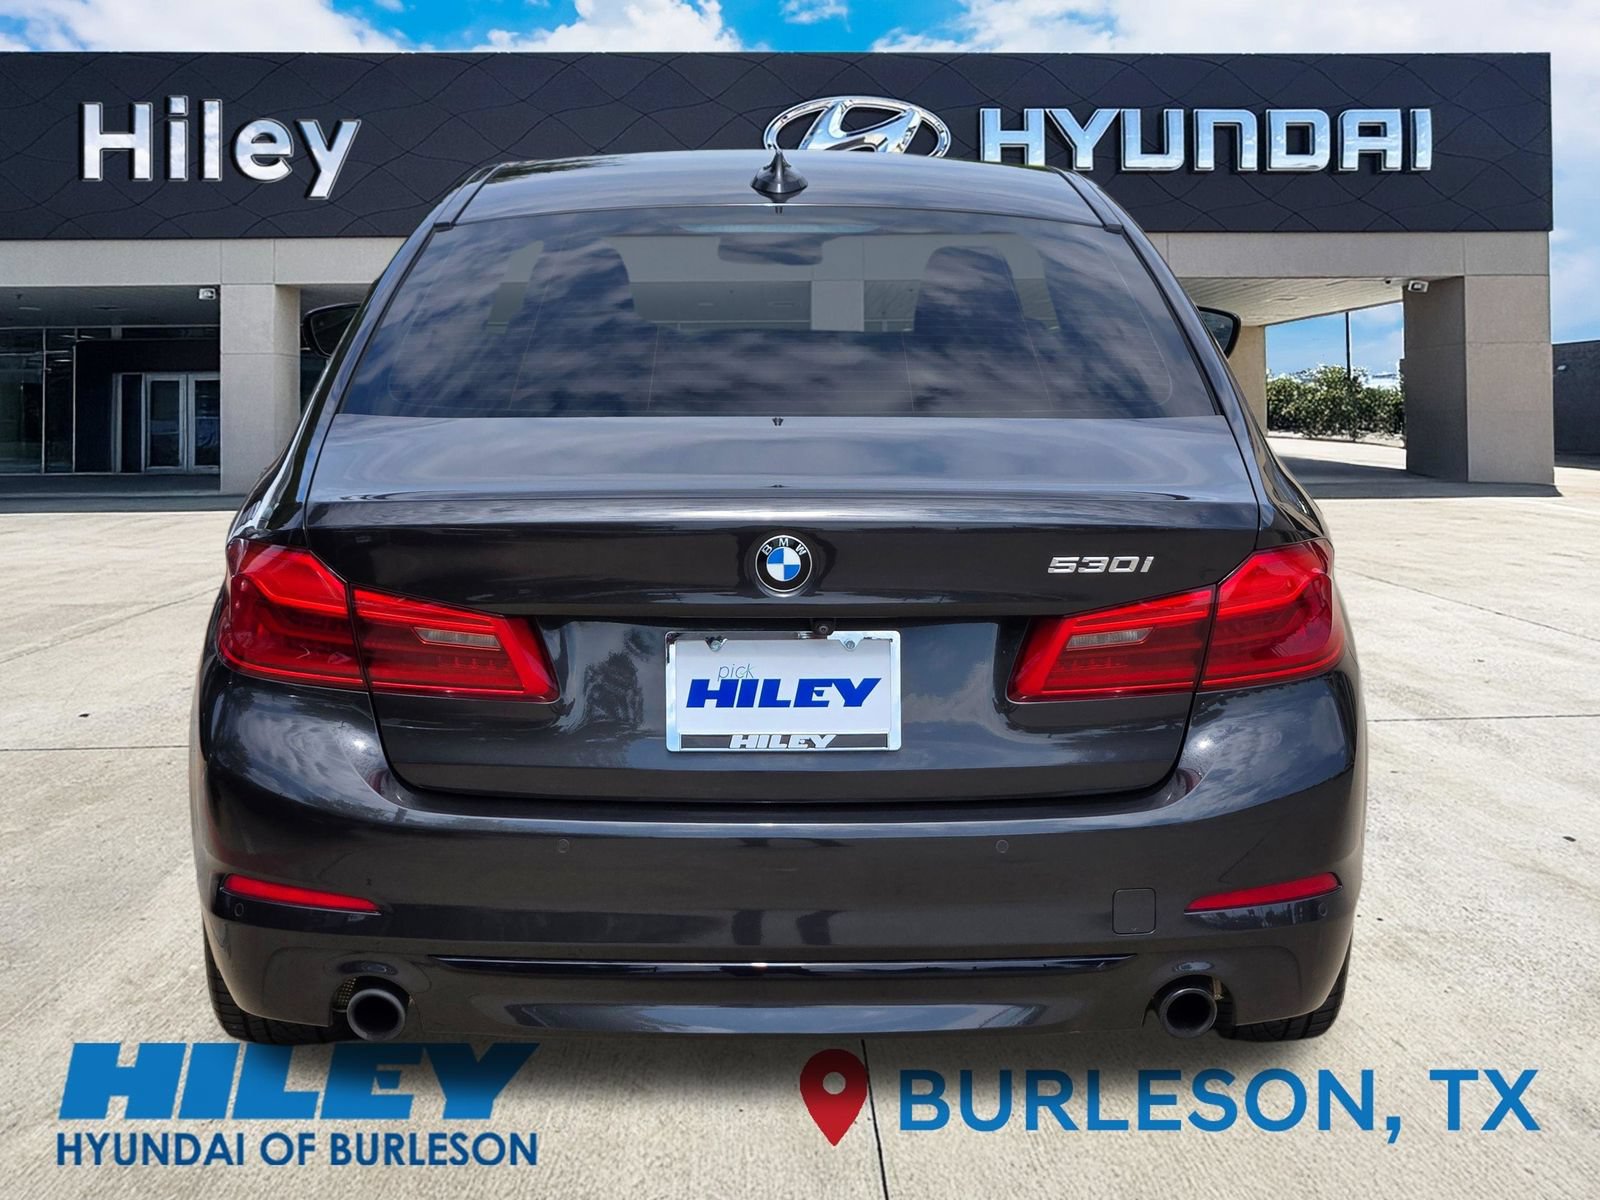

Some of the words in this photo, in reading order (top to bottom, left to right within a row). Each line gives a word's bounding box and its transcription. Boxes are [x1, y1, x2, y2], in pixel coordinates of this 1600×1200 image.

[81, 95, 361, 199] Hiley
[980, 107, 1432, 172] HYUNDAI
[761, 537, 807, 556] BMW
[717, 663, 755, 682] pick
[686, 677, 882, 708] HILEY
[729, 734, 837, 749] HILEY
